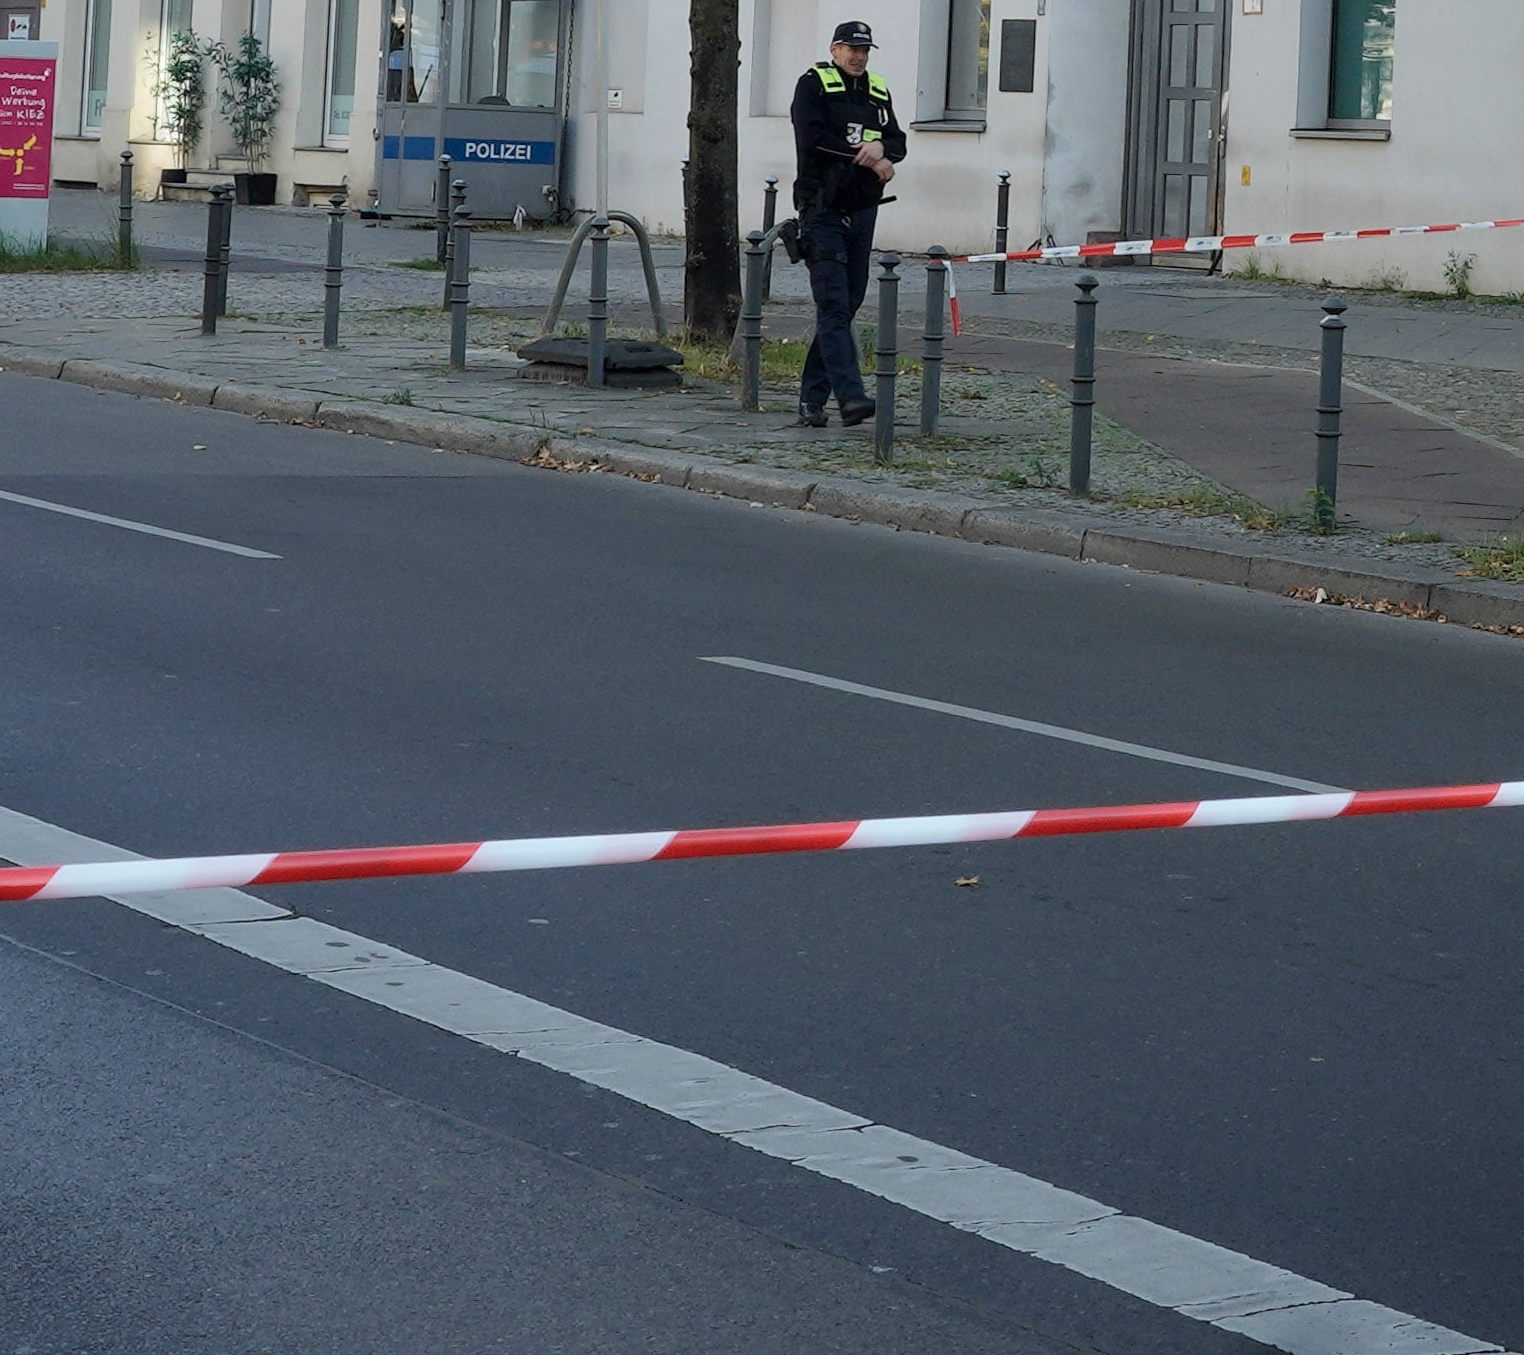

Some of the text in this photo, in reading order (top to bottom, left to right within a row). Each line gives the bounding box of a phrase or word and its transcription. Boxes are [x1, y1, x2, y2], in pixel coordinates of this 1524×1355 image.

[10, 85, 38, 96] Deine
[1, 96, 46, 110] Werbung
[16, 109, 45, 120] KIEZ
[465, 142, 532, 160] POLIZEI
